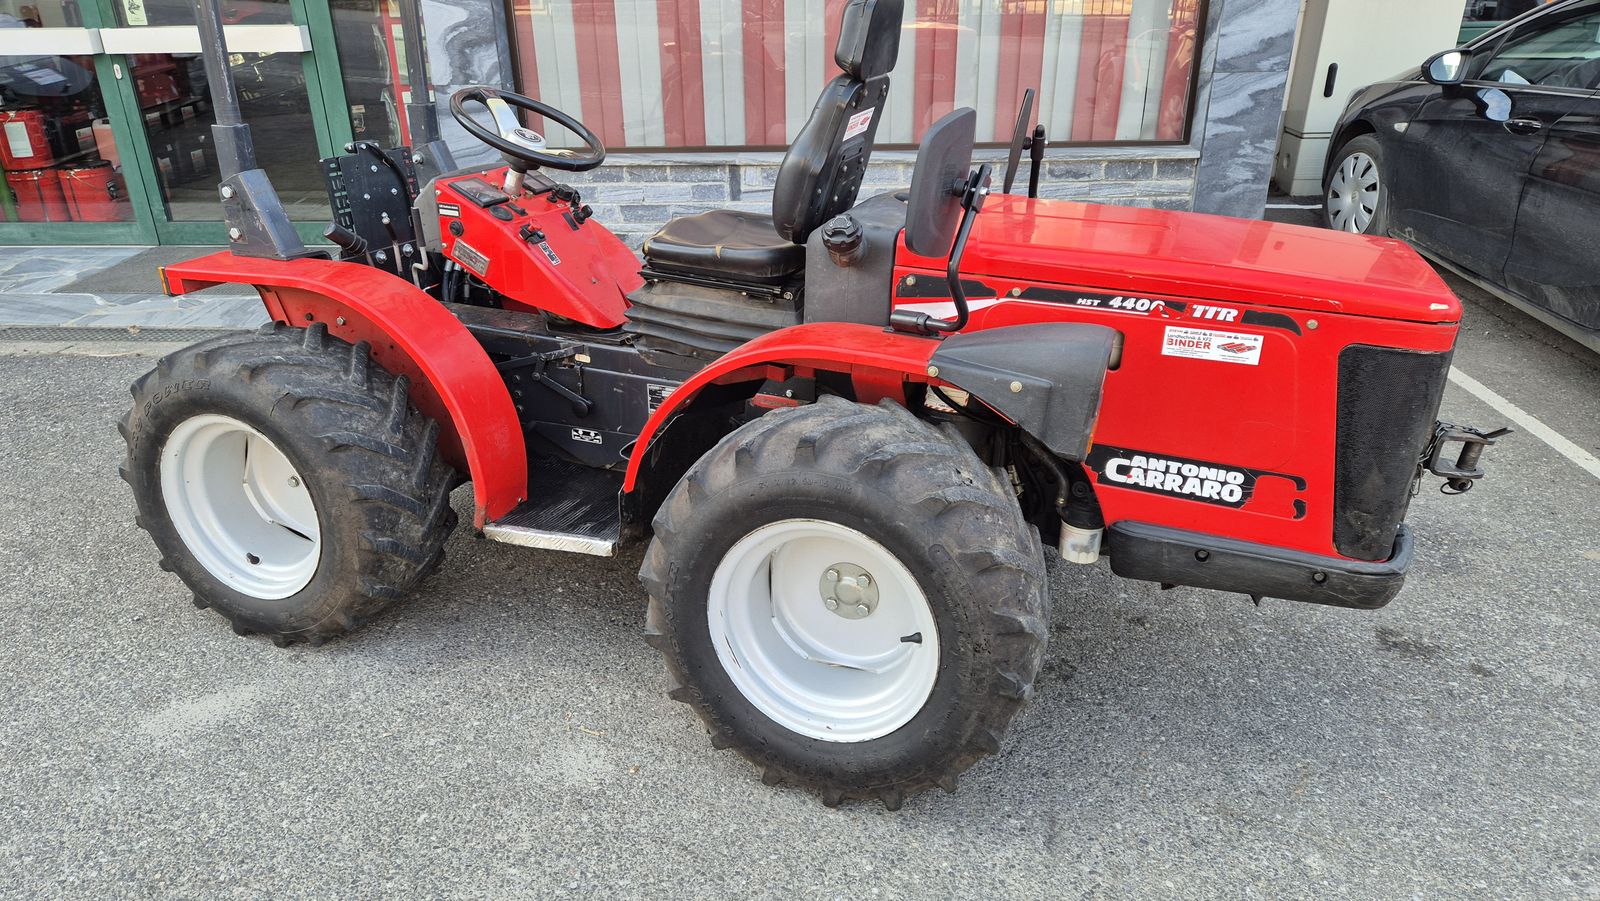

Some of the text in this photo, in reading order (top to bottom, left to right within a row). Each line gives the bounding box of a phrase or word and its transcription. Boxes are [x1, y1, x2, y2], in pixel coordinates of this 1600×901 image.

[1076, 298, 1101, 306] HST
[1192, 304, 1239, 322] TTR
[1166, 338, 1212, 350] BINDER
[1167, 333, 1197, 341] Landtechnik
[144, 378, 211, 417] POWER
[1130, 455, 1245, 485] ANTONIO
[1105, 458, 1243, 503] CARRARO
